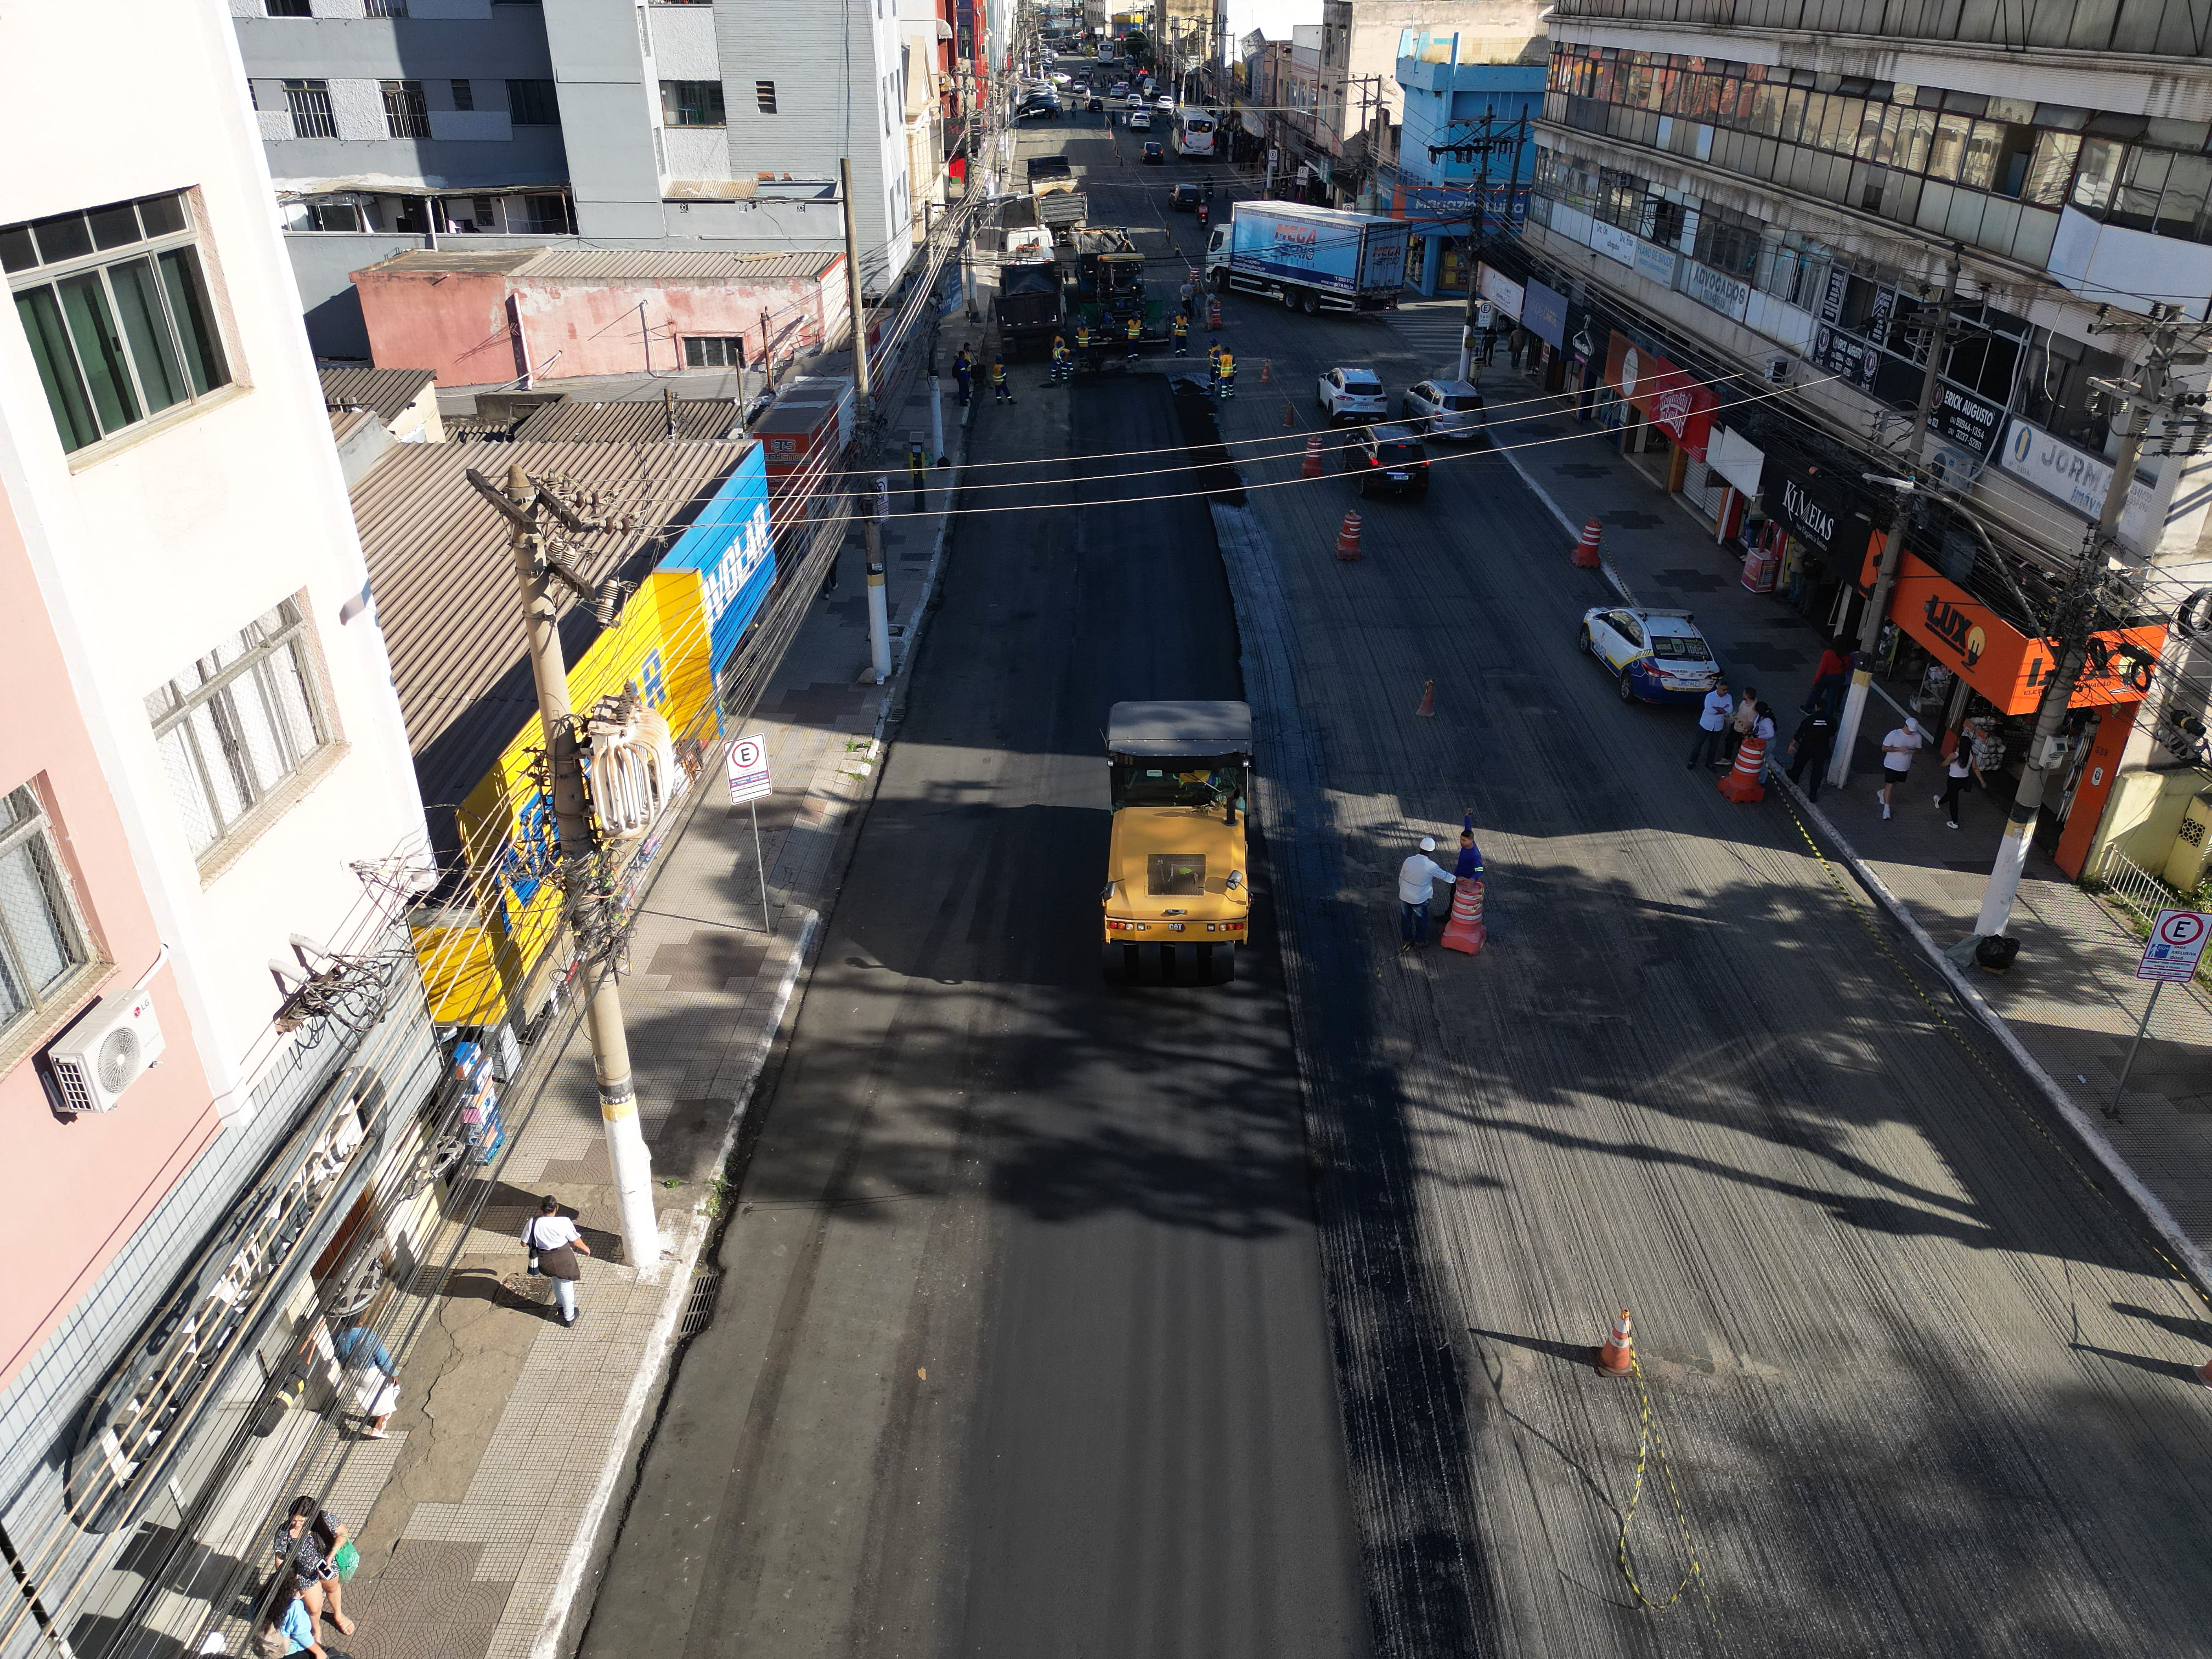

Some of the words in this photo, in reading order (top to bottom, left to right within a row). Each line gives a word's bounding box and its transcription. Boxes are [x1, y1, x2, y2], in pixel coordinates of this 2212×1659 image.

[1274, 223, 1317, 245] MEGA
[1373, 246, 1401, 257] MEGA
[1637, 243, 1651, 258] PLANO
[1694, 266, 1745, 304] ADVOGADOS
[1944, 390, 1963, 411] ERICK
[1961, 399, 1994, 427] AUGUSTO
[1955, 417, 1985, 439] 99944-1354
[1955, 429, 1982, 451] 3337-5280
[2071, 486, 2102, 512] imóve
[1926, 594, 1973, 649] LUX
[741, 747, 751, 762] E
[2172, 921, 2191, 938] E
